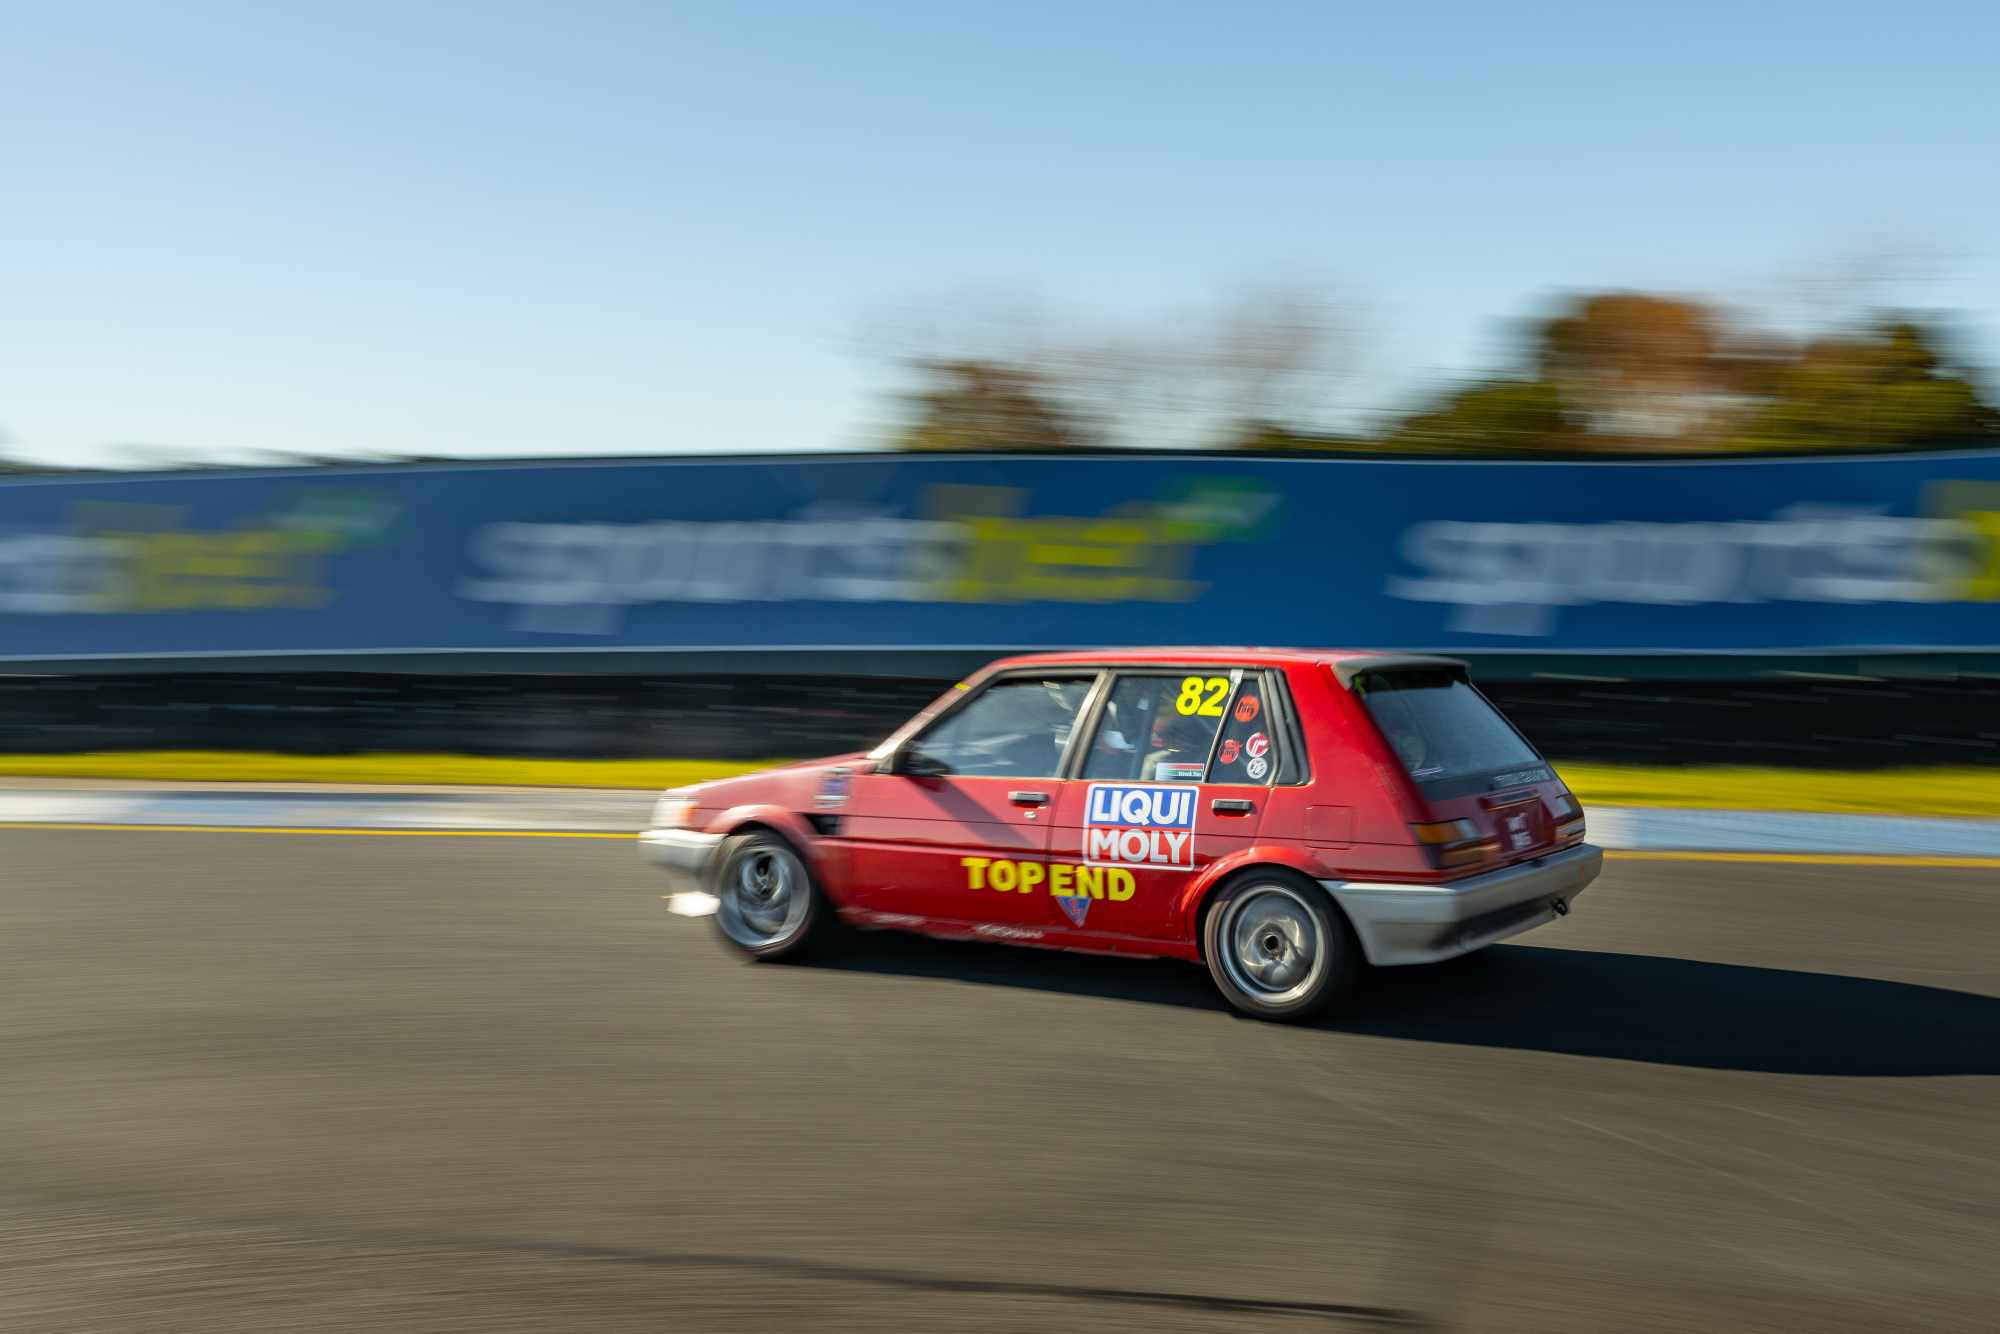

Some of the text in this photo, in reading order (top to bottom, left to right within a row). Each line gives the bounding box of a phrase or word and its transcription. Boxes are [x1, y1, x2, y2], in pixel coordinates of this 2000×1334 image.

[1175, 677, 1229, 717] 82
[1092, 790, 1191, 825] LIQUI
[1090, 828, 1190, 864] MOLY
[960, 857, 1136, 902] TOP END
